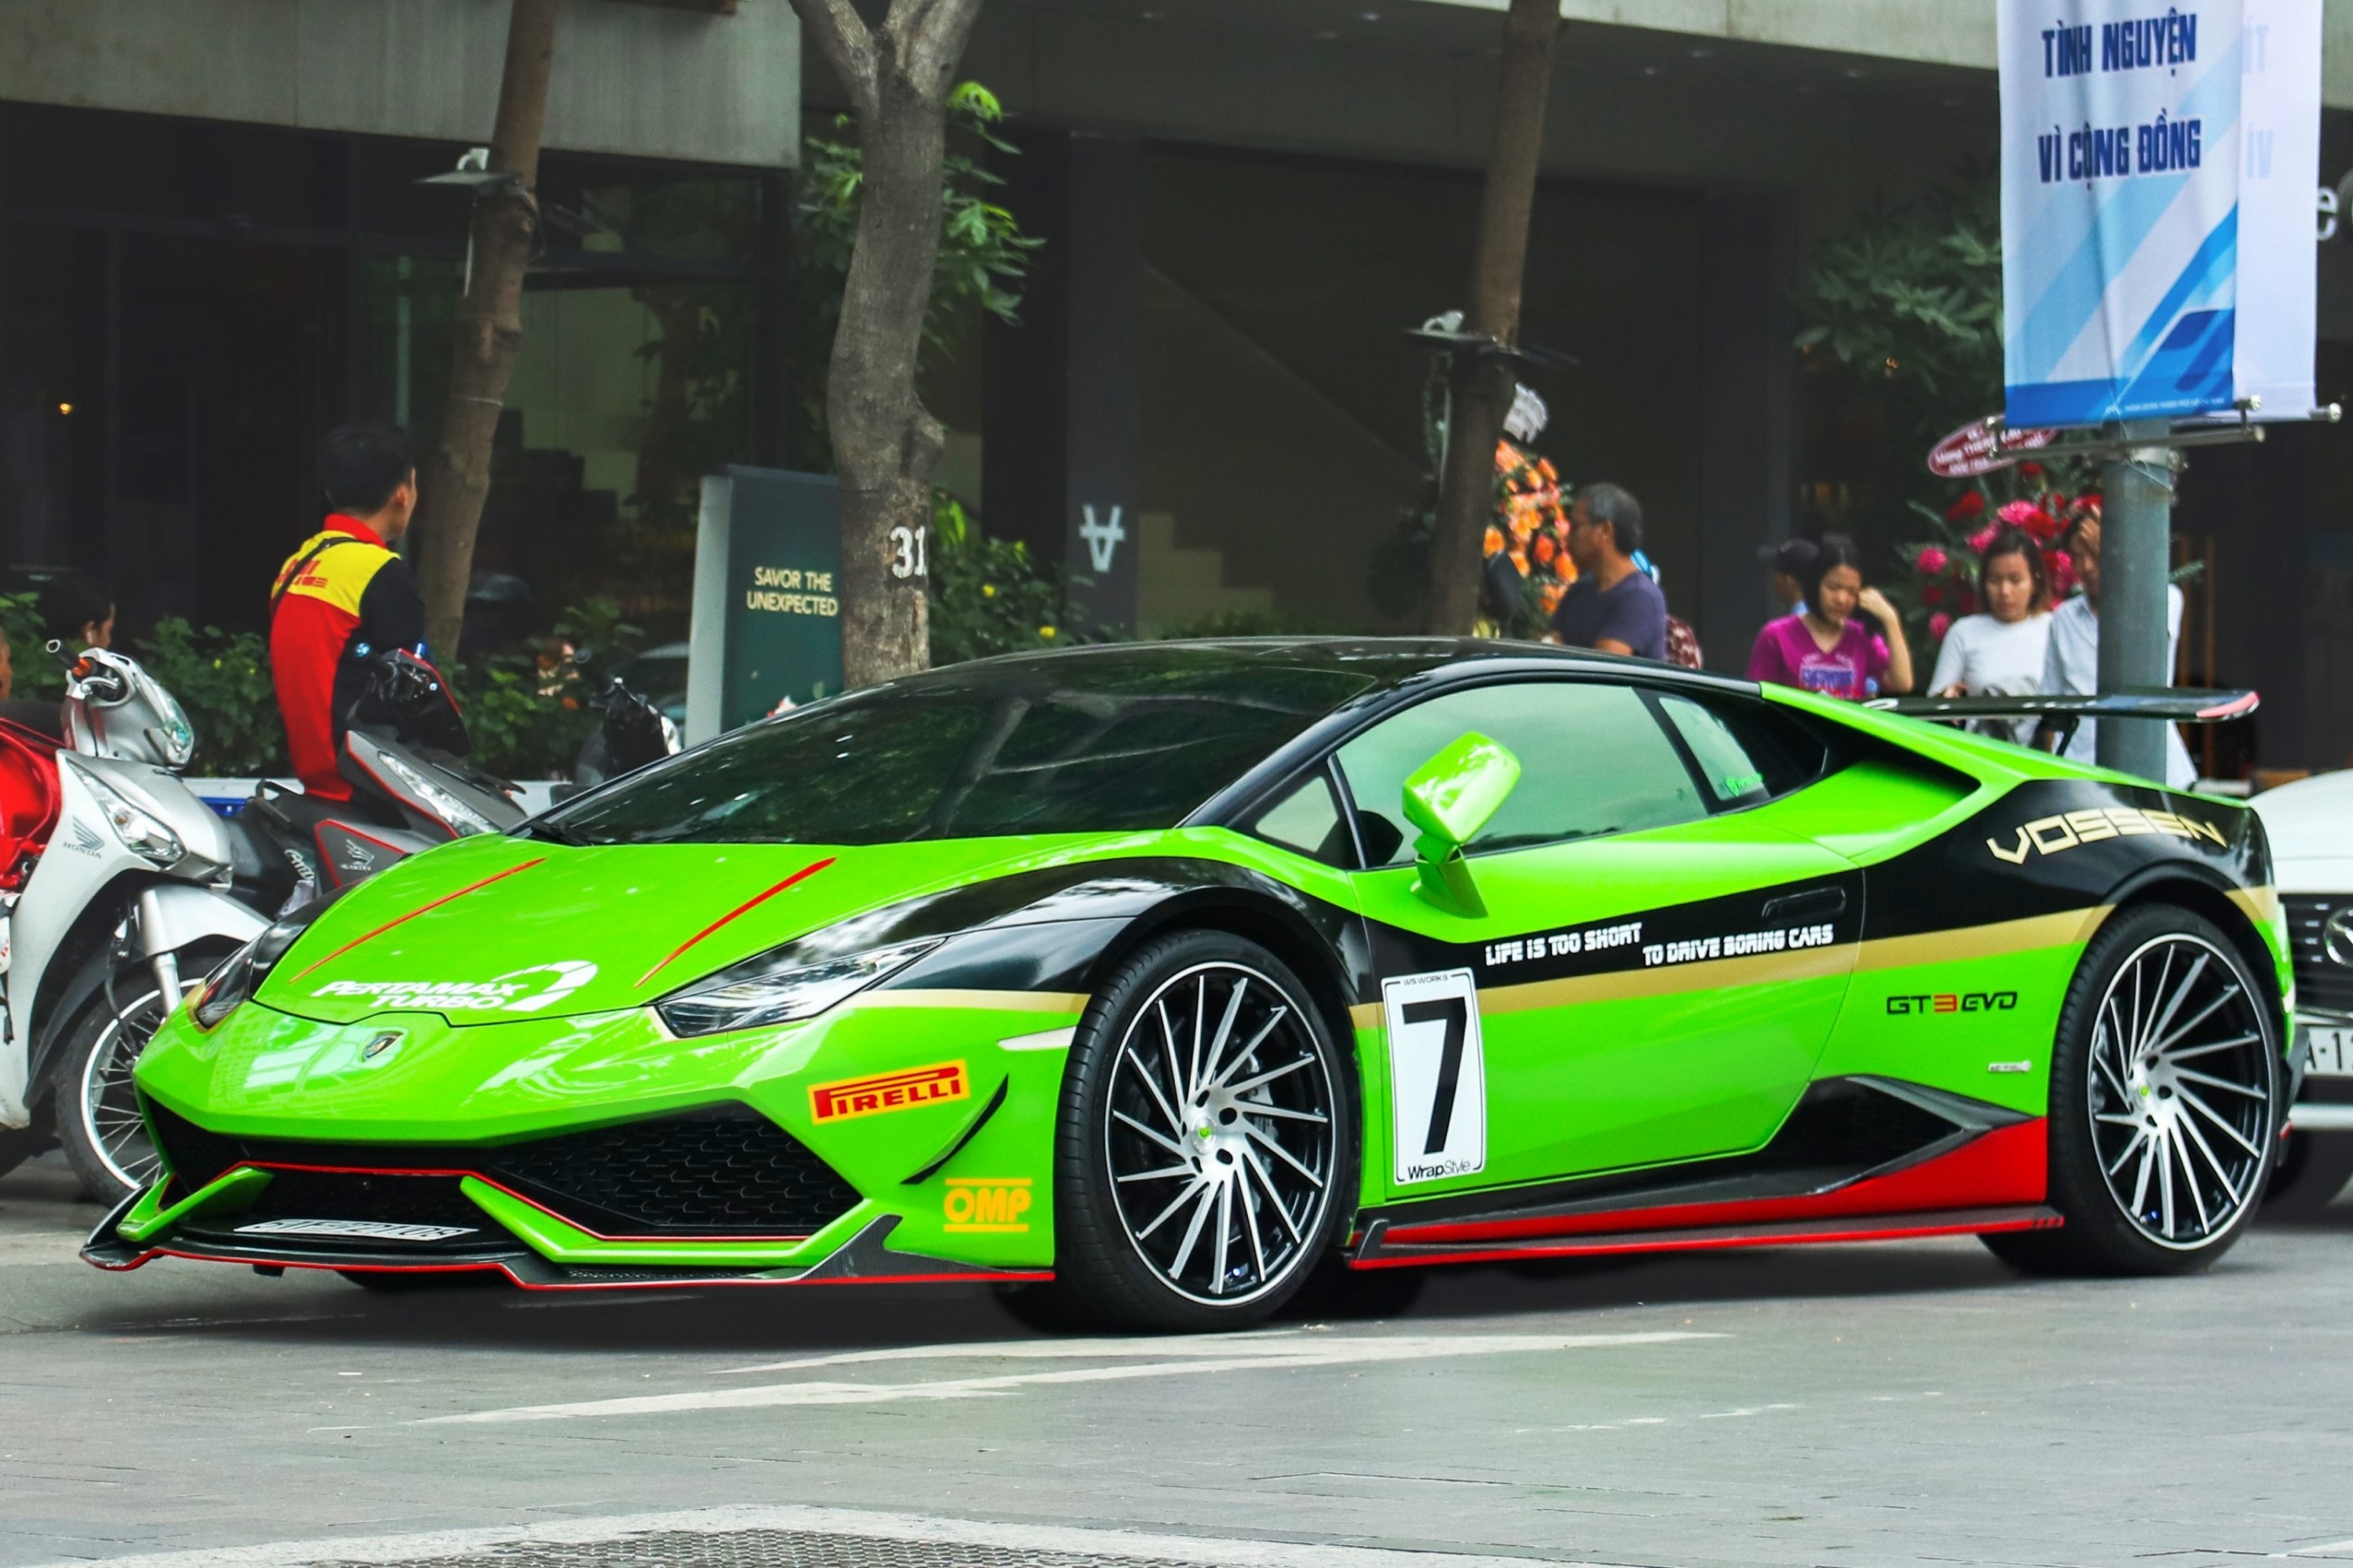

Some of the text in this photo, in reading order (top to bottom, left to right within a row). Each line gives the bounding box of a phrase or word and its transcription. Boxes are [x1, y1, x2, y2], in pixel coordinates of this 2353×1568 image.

[2041, 7, 2197, 78] TÌNH NGUYỆN
[2038, 108, 2201, 190] VÌ CỘNG ĐỒNG
[890, 525, 926, 578] 31
[755, 566, 832, 592] SAVOR THE
[746, 591, 839, 617] UNEXPECTED
[1986, 807, 2228, 866] VOSSEN
[1486, 923, 1643, 966] LIFE IS TOO SHORT
[1643, 923, 1834, 966] TO DRIVE BORING CARS
[310, 980, 529, 997] PERTAMAX
[368, 994, 505, 1009] TURBO
[813, 1066, 961, 1119] PIRELLI
[1402, 997, 1467, 1155] 7
[1408, 1159, 1471, 1181] WrapStyle
[943, 1187, 1032, 1223] OMP
